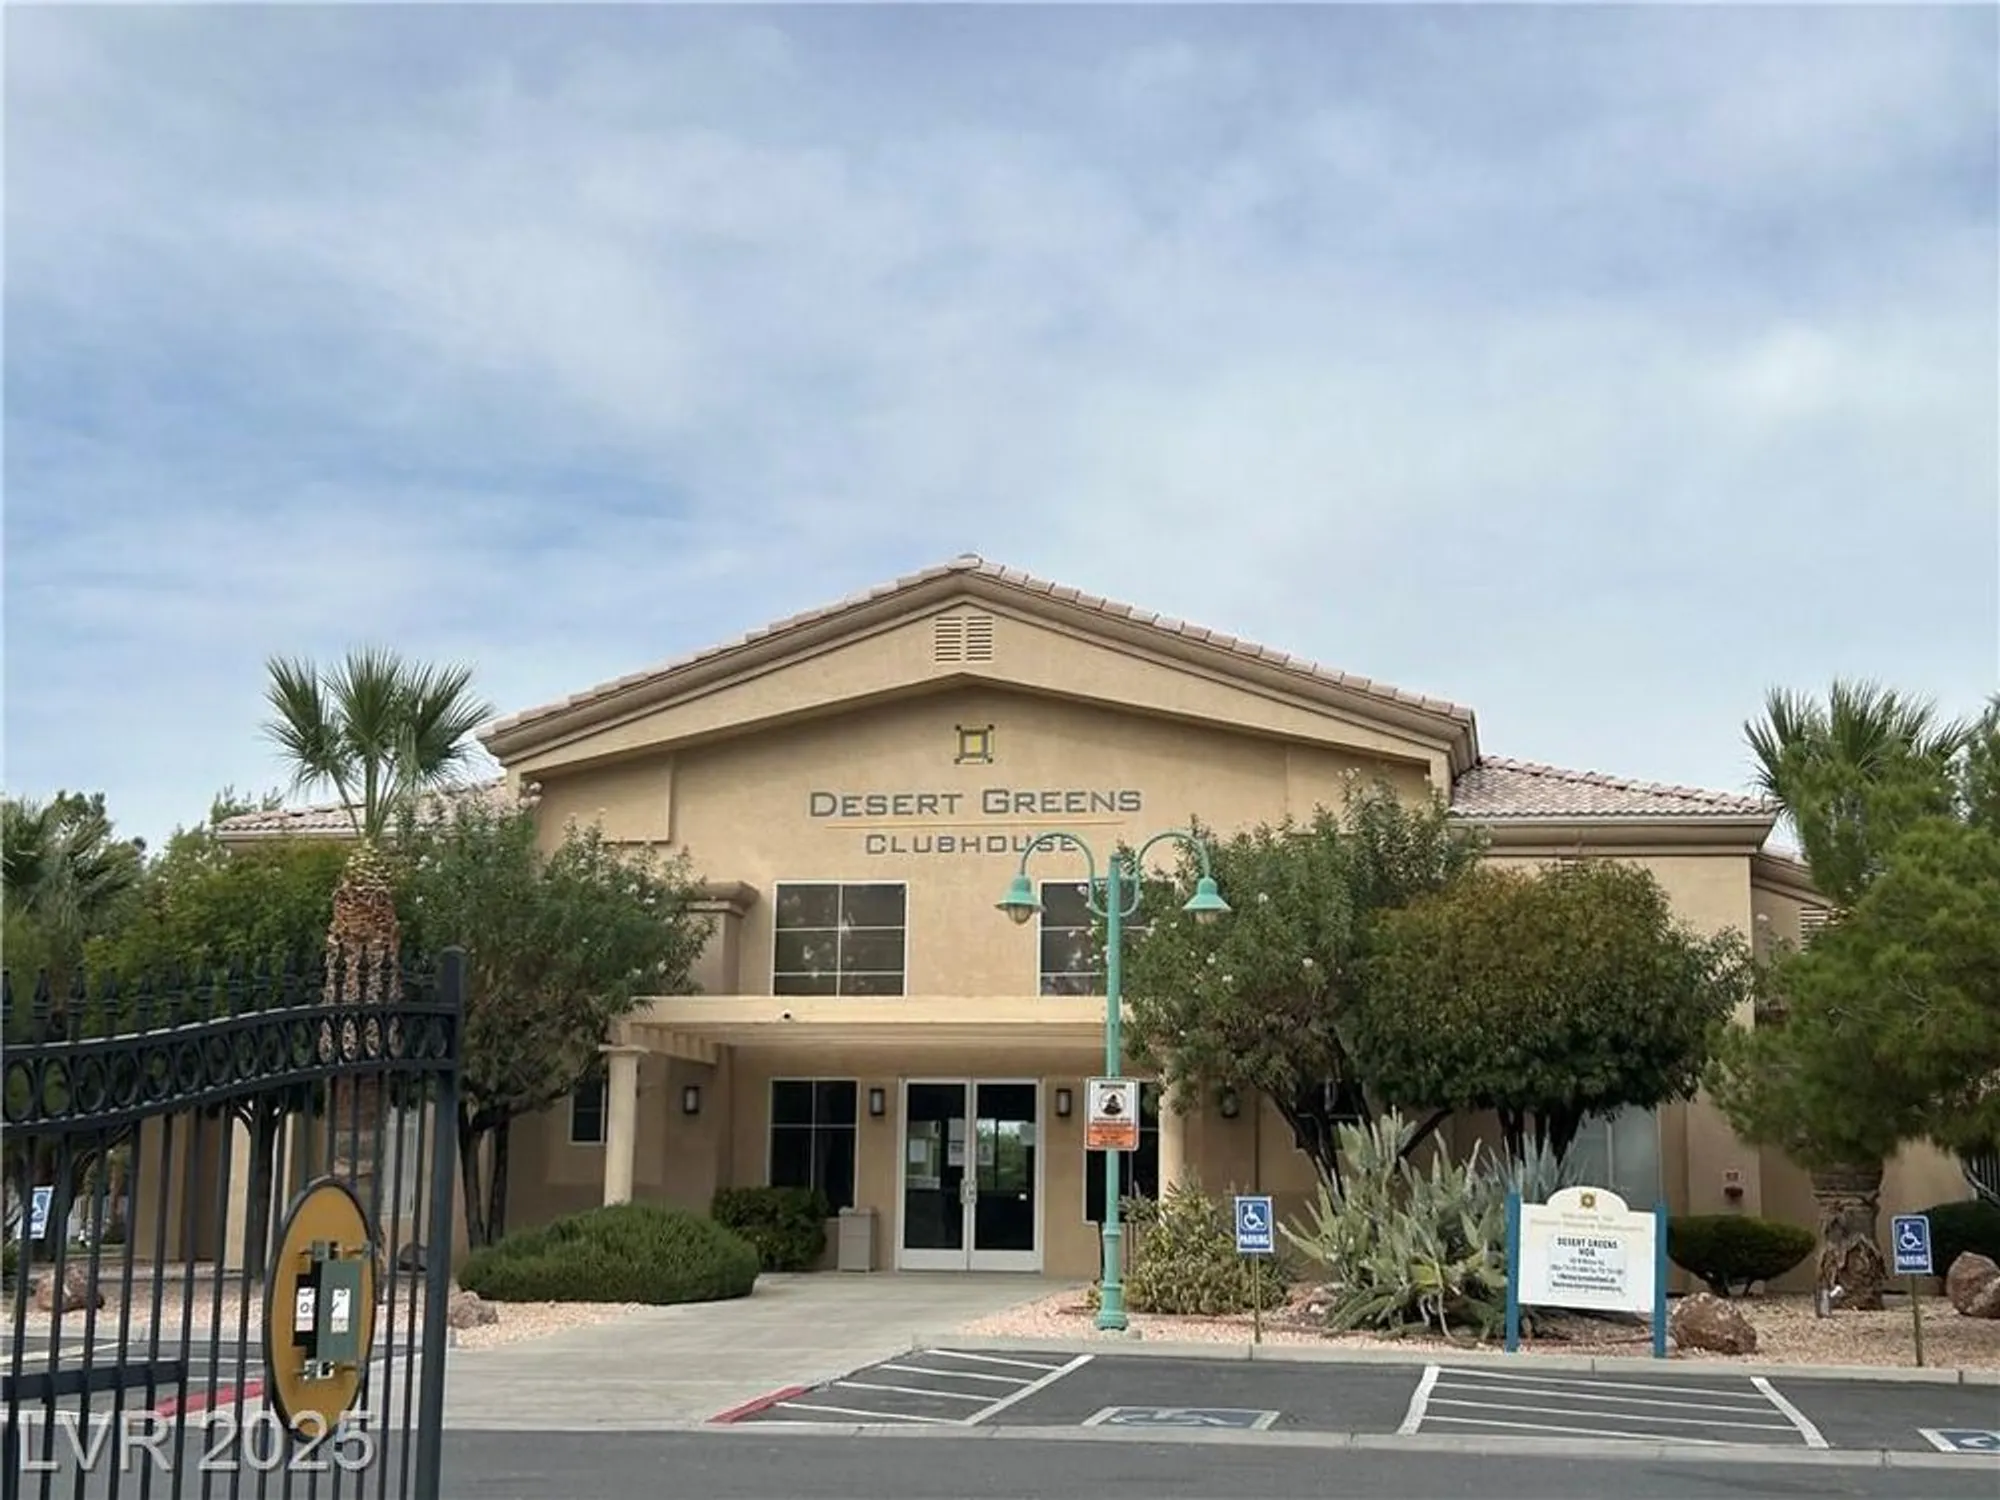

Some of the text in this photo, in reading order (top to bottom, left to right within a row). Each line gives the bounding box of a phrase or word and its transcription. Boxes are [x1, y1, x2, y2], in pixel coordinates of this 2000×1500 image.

[810, 789, 1142, 817] DESERT GREENS
[866, 834, 1078, 855] CLUBHOUSE
